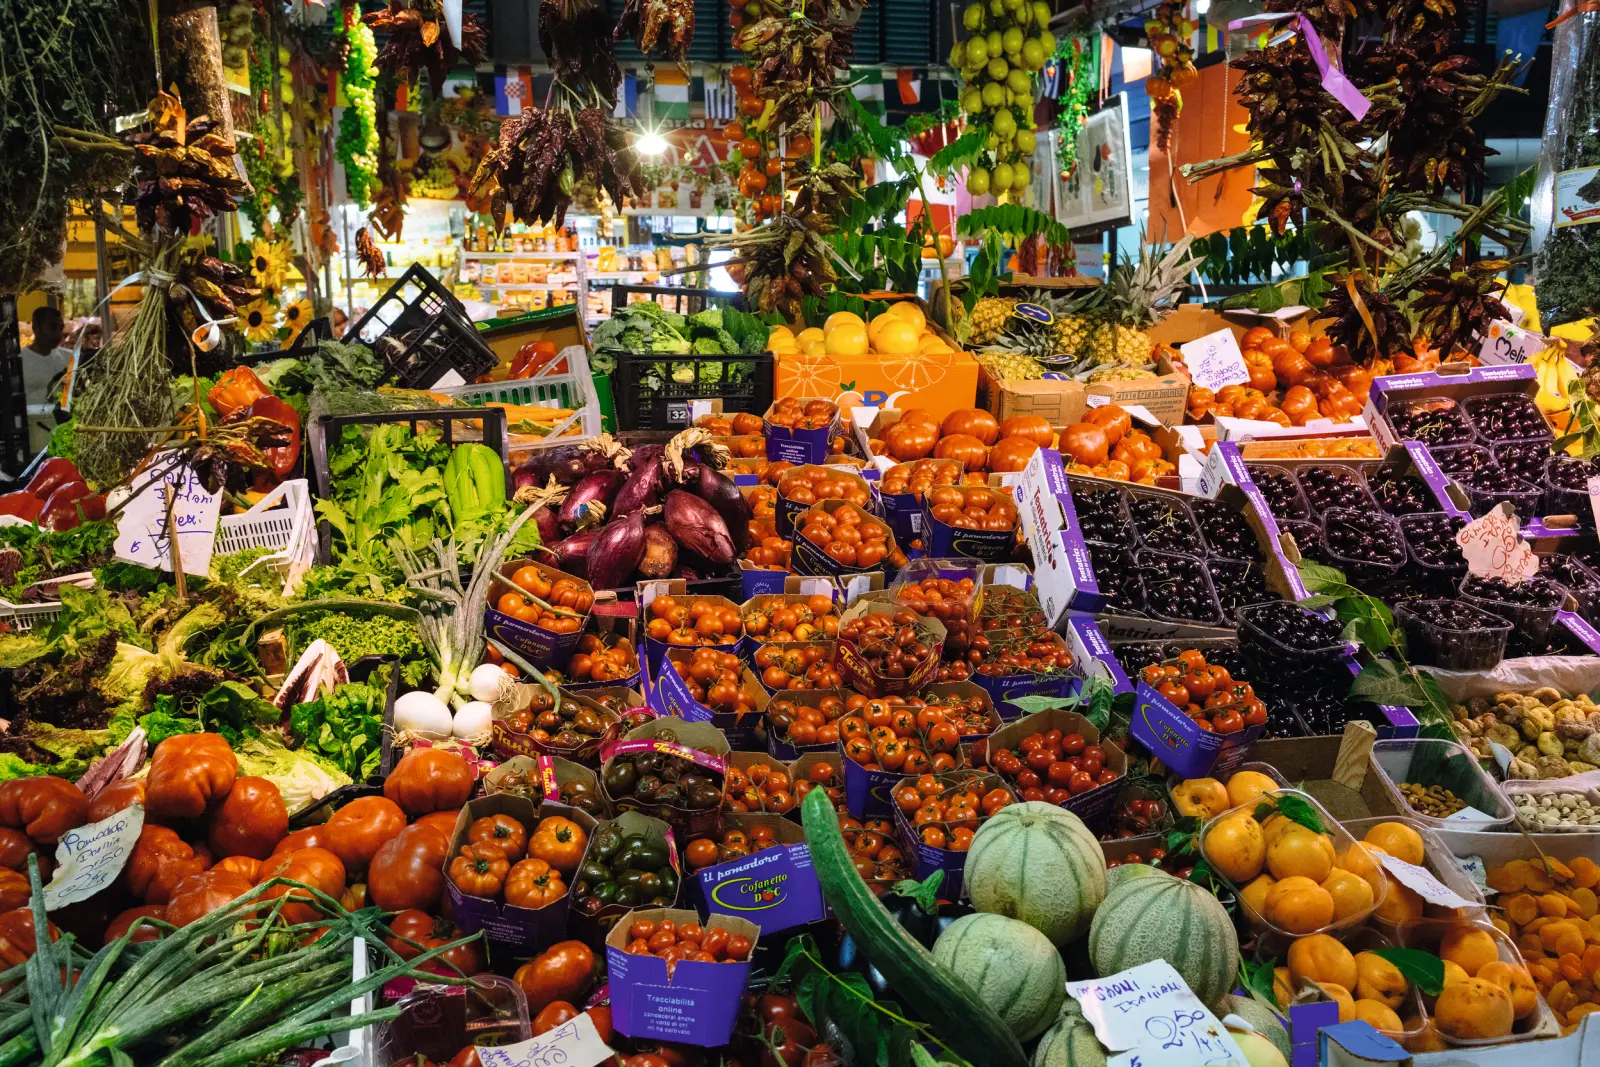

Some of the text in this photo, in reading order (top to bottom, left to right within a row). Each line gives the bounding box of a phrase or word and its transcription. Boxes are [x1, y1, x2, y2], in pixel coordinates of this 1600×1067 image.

[672, 411, 686, 420] 32
[1049, 464, 1063, 494] Tentatrici
[1033, 486, 1052, 550] Tentatrici
[1072, 548, 1088, 583] Tentatrici
[1151, 697, 1195, 733] pomodoro
[493, 725, 541, 758] Tania
[1159, 719, 1189, 747] Cofanetto
[653, 742, 695, 761] Tania
[542, 767, 552, 796] Tania
[704, 872, 714, 883] il
[717, 852, 783, 881] pomodoro
[740, 873, 788, 895] Cofanetto
[647, 994, 695, 1006] Tracciabilità
[658, 1006, 683, 1014] online
[643, 1012, 677, 1020] conoscerai
